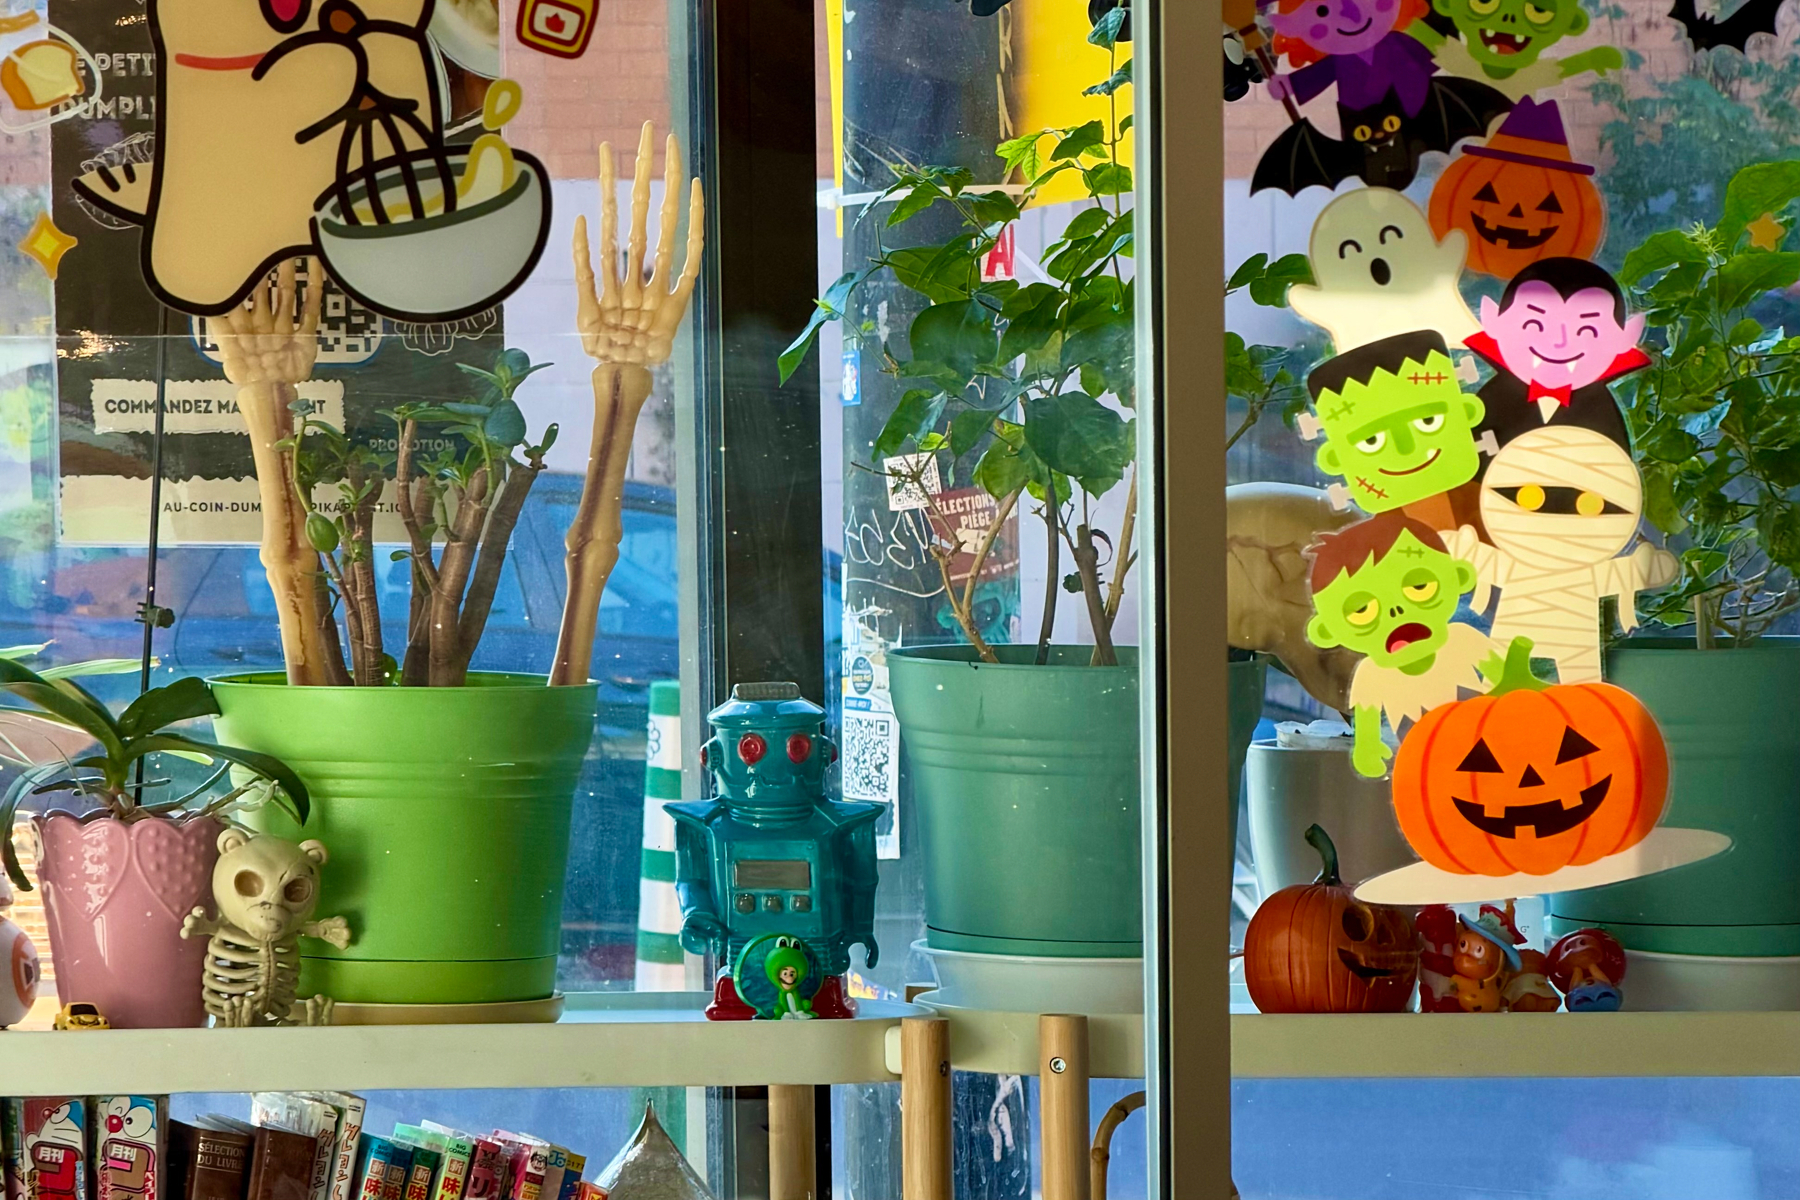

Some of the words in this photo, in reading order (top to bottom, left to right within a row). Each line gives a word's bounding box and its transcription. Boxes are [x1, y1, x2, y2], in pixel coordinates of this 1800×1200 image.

[95, 52, 156, 77] PETI
[104, 399, 213, 414] COMMANDEZ
[369, 439, 455, 452] PROOTION
[960, 509, 991, 530] PIÈGE
[38, 1146, 65, 1163] 月刊
[110, 1144, 137, 1162] 月刊
[198, 1140, 245, 1158] SÉLECTION
[448, 1148, 471, 1157] COMICS
[197, 1154, 212, 1165] DU
[216, 1156, 243, 1170] LIVRE
